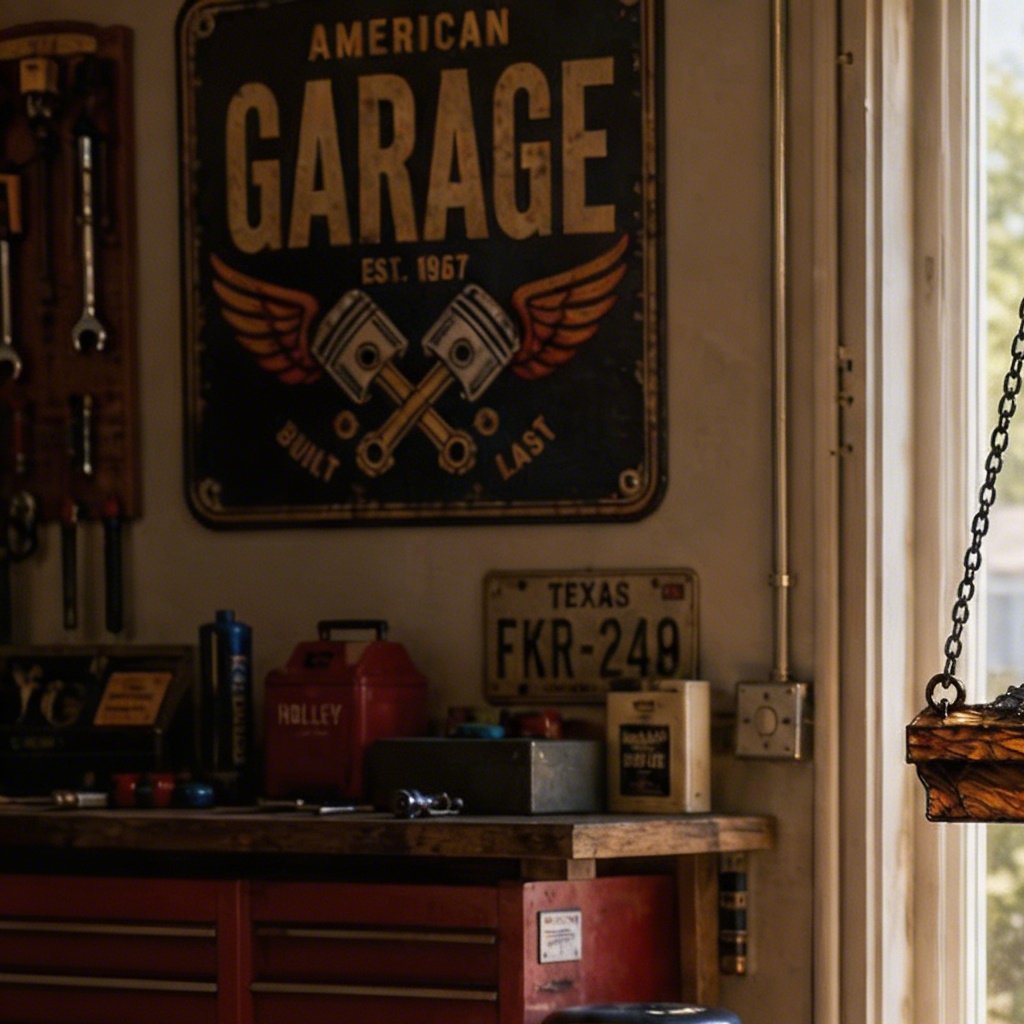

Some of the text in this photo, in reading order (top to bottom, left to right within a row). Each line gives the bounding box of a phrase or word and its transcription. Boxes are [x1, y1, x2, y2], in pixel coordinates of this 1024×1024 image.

[308, 8, 510, 61] AMERICAN
[225, 56, 617, 254] GARAGE
[361, 253, 470, 286] EST. 1967
[275, 413, 557, 483] BUILT LAST
[549, 582, 630, 608] TEXAS
[277, 703, 343, 726] HOLLEY
